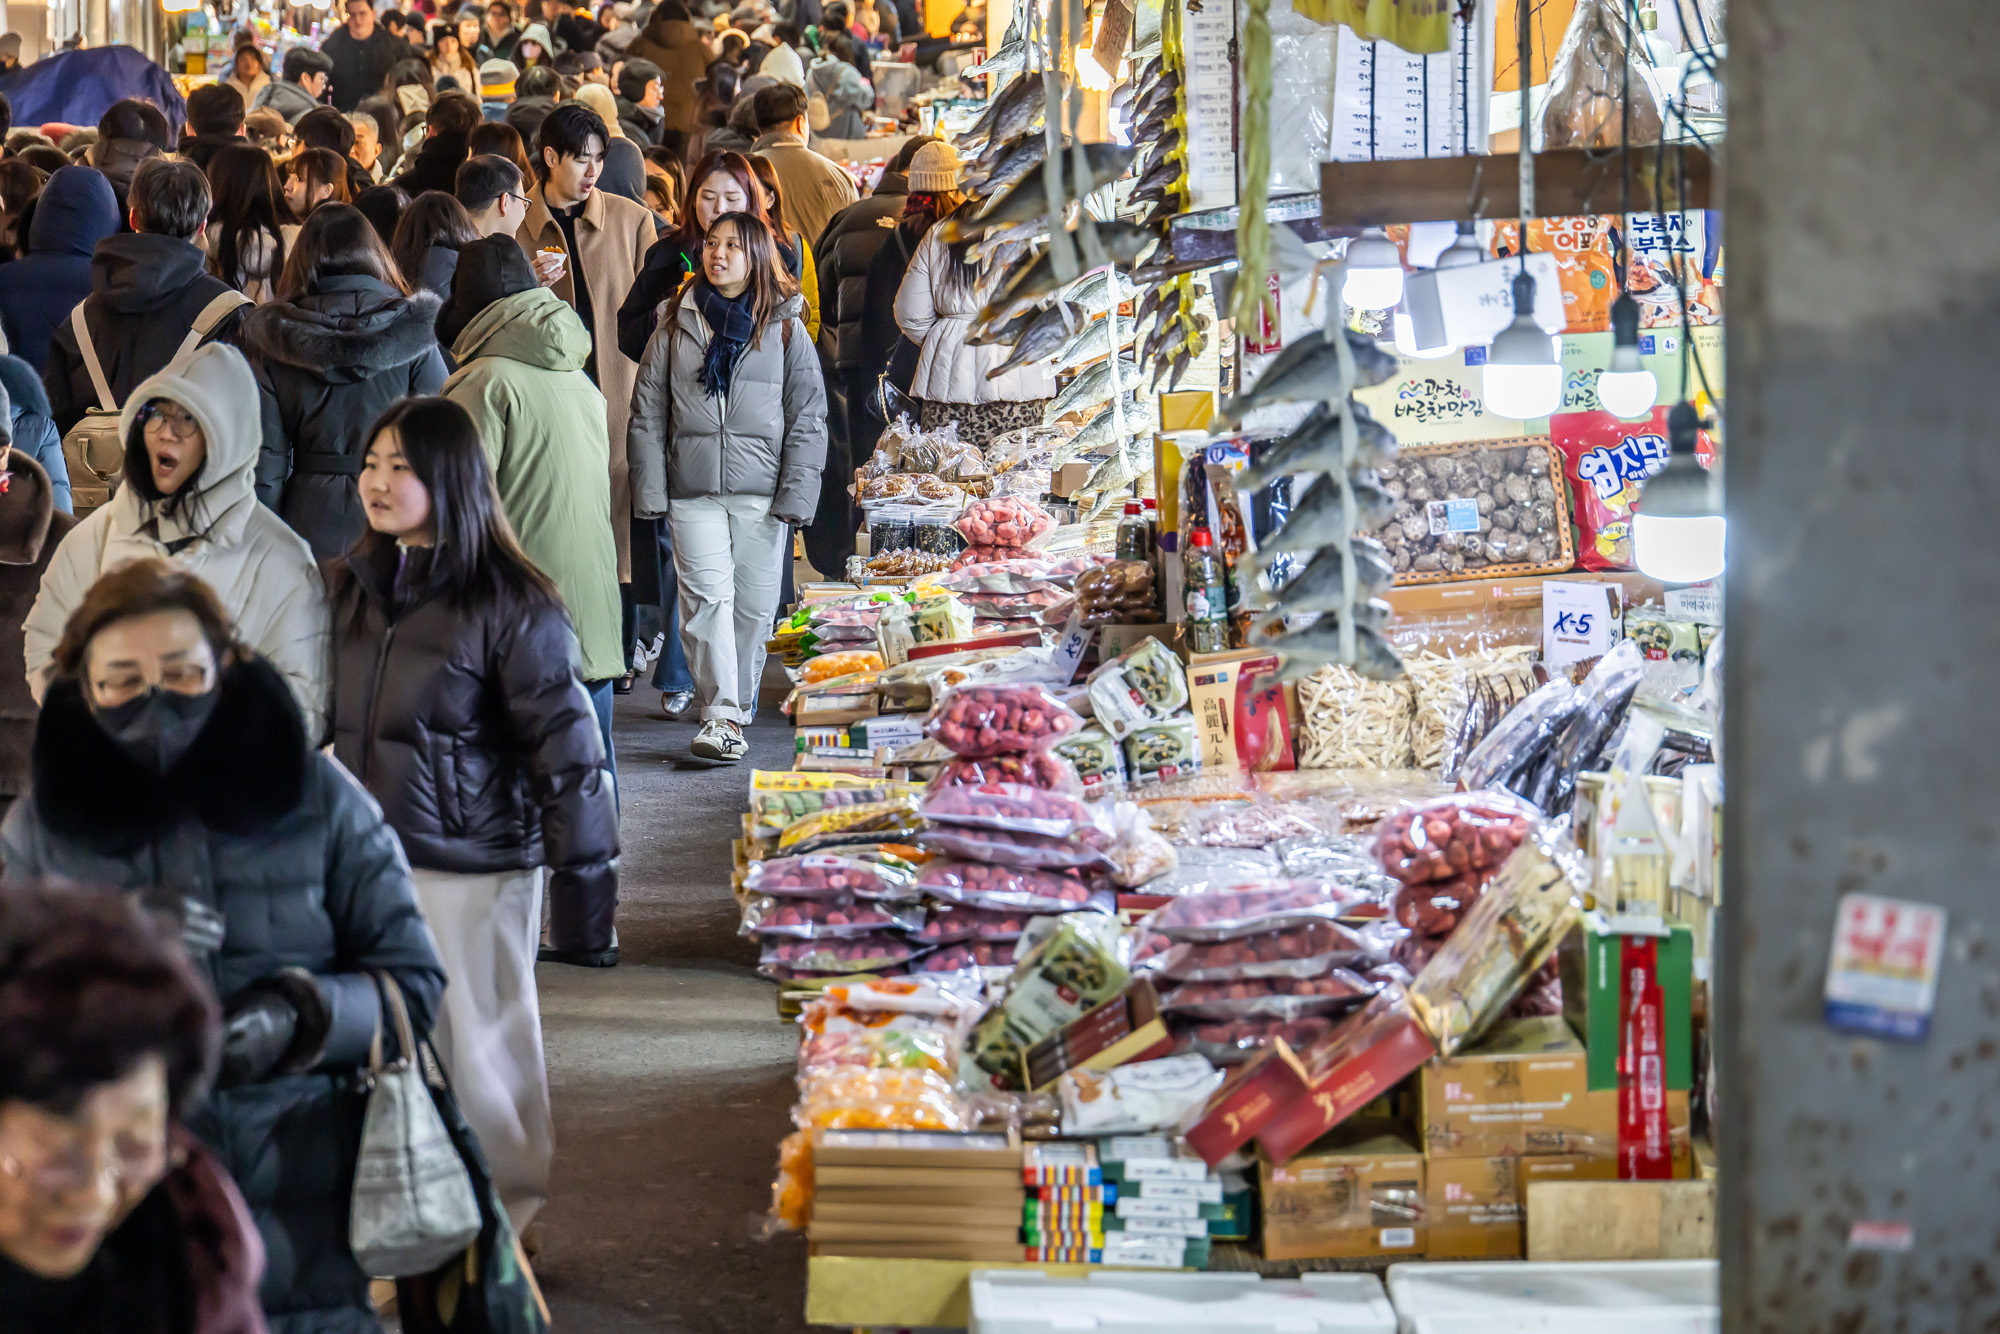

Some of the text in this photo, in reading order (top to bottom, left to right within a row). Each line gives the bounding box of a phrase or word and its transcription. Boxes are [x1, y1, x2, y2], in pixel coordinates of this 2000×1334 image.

[1632, 214, 1686, 234] 누룽지
[1424, 378, 1462, 400] 광천
[1562, 388, 1602, 412] 바른
[1394, 398, 1484, 423] 바른찬맛김
[1680, 599, 1720, 612] 미역국라
[1553, 611, 1595, 637] X-5
[1065, 632, 1083, 659] X-5
